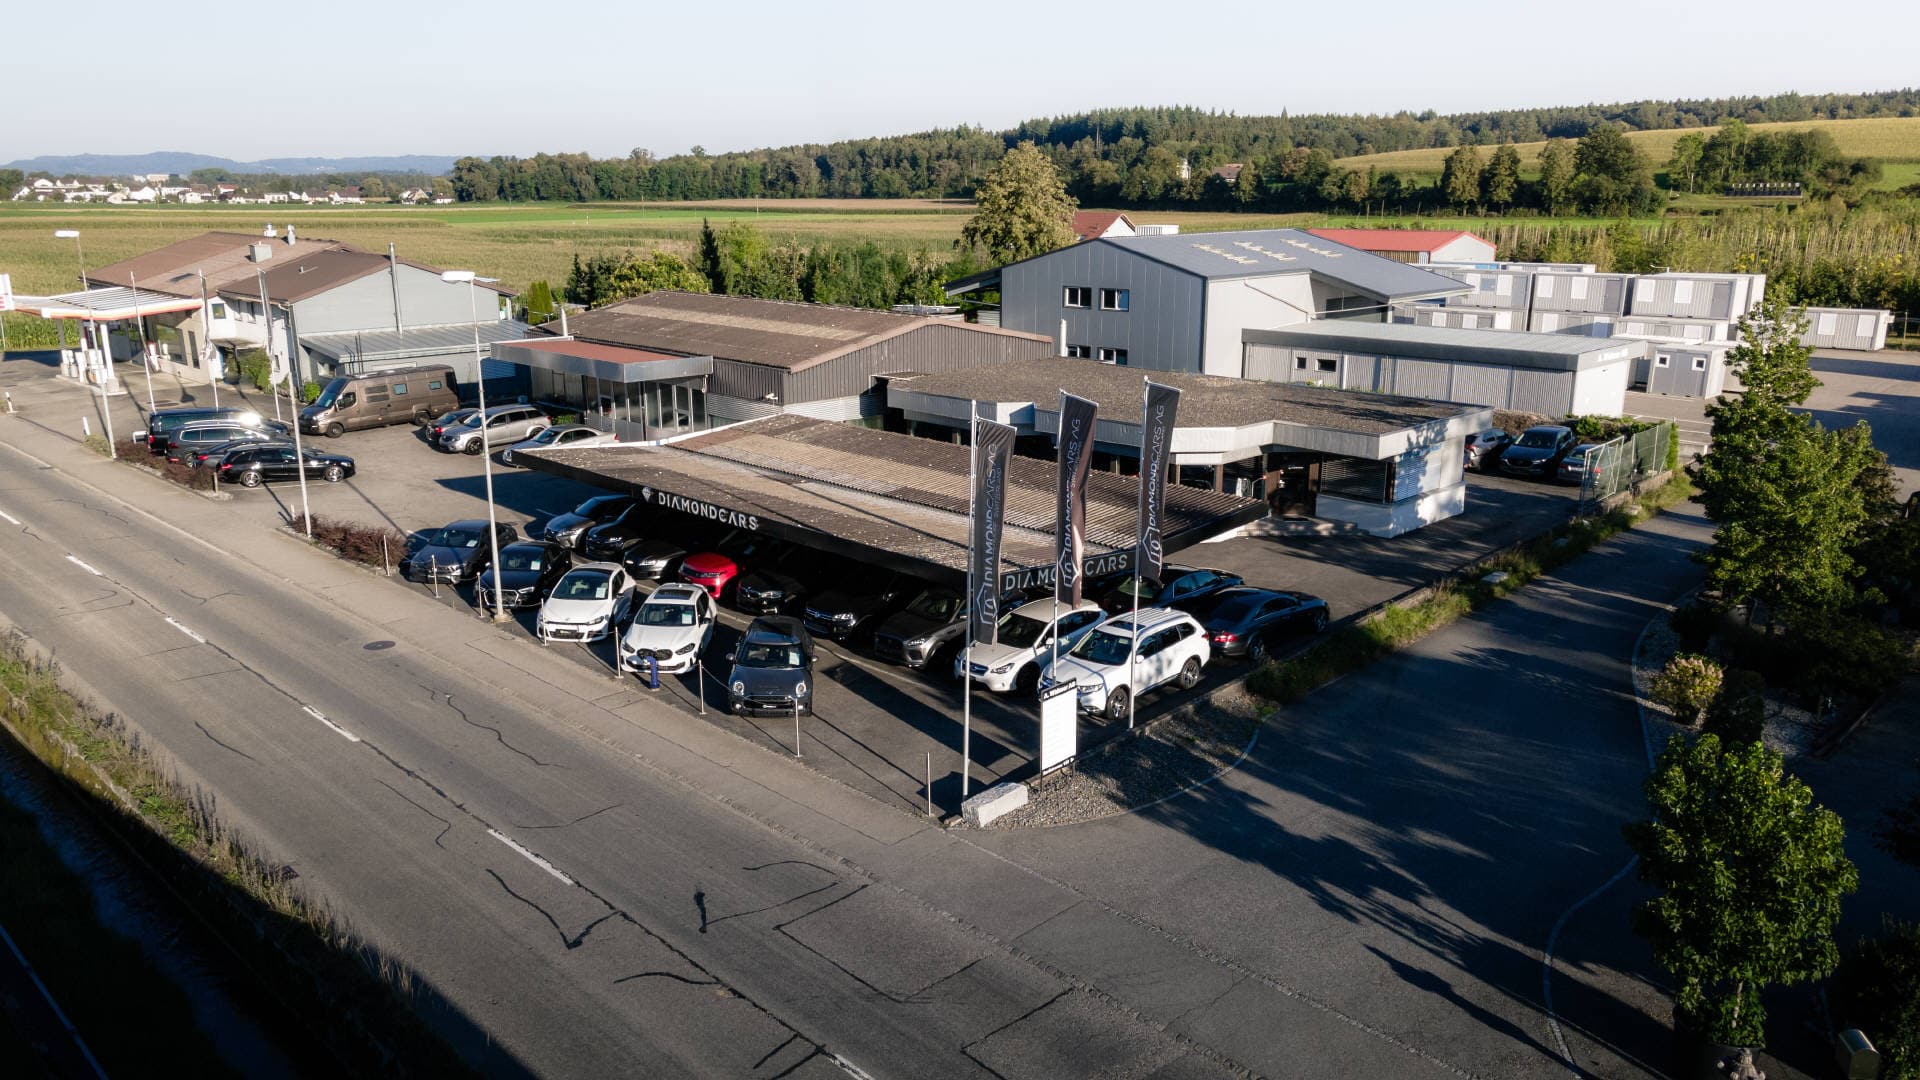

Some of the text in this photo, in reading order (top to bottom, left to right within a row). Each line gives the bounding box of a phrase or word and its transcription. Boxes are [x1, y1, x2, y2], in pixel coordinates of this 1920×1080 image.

[1071, 418, 1081, 440] AG
[1148, 426, 1162, 527] DIAMONDCARS
[1156, 404, 1165, 425] AG
[658, 491, 759, 531] DIAMONDCARS
[1005, 553, 1128, 591] DIAMOCARS
